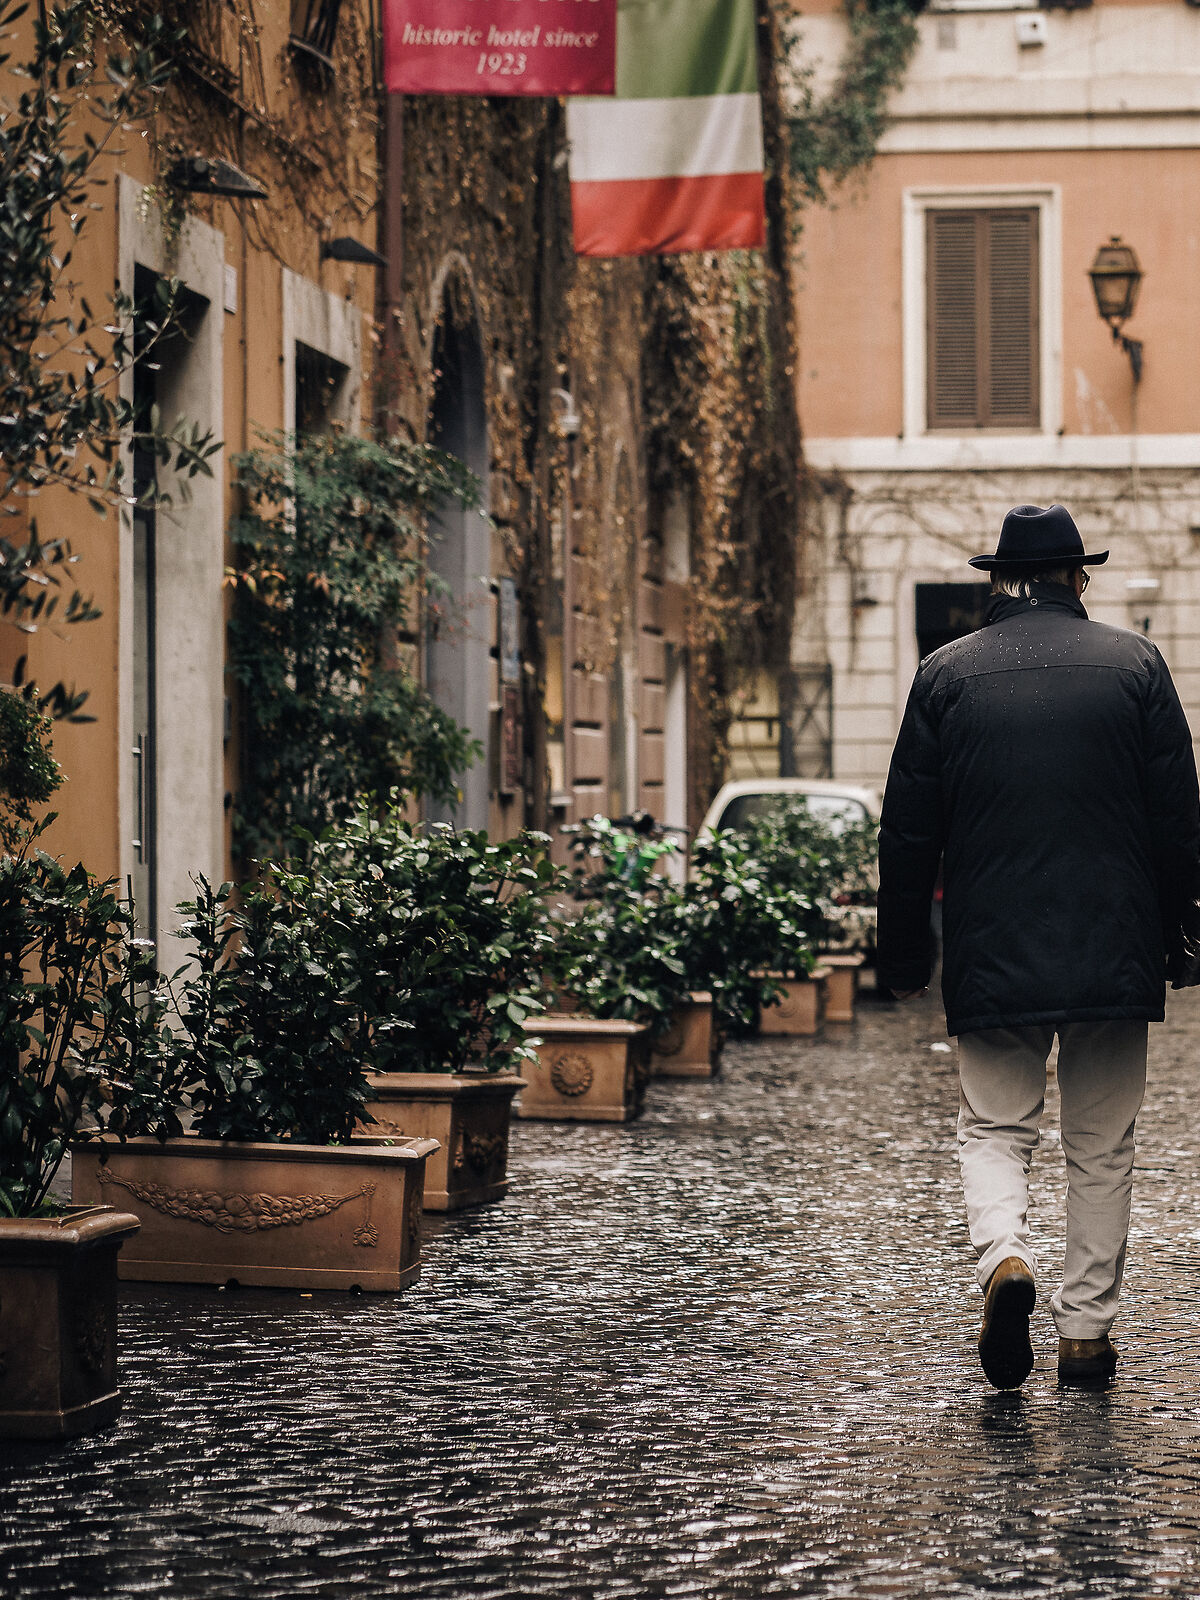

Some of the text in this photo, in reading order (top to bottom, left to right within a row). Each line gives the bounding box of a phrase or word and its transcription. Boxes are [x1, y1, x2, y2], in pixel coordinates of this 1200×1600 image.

[402, 22, 599, 48] historic hotel since
[476, 52, 527, 75] 1923
